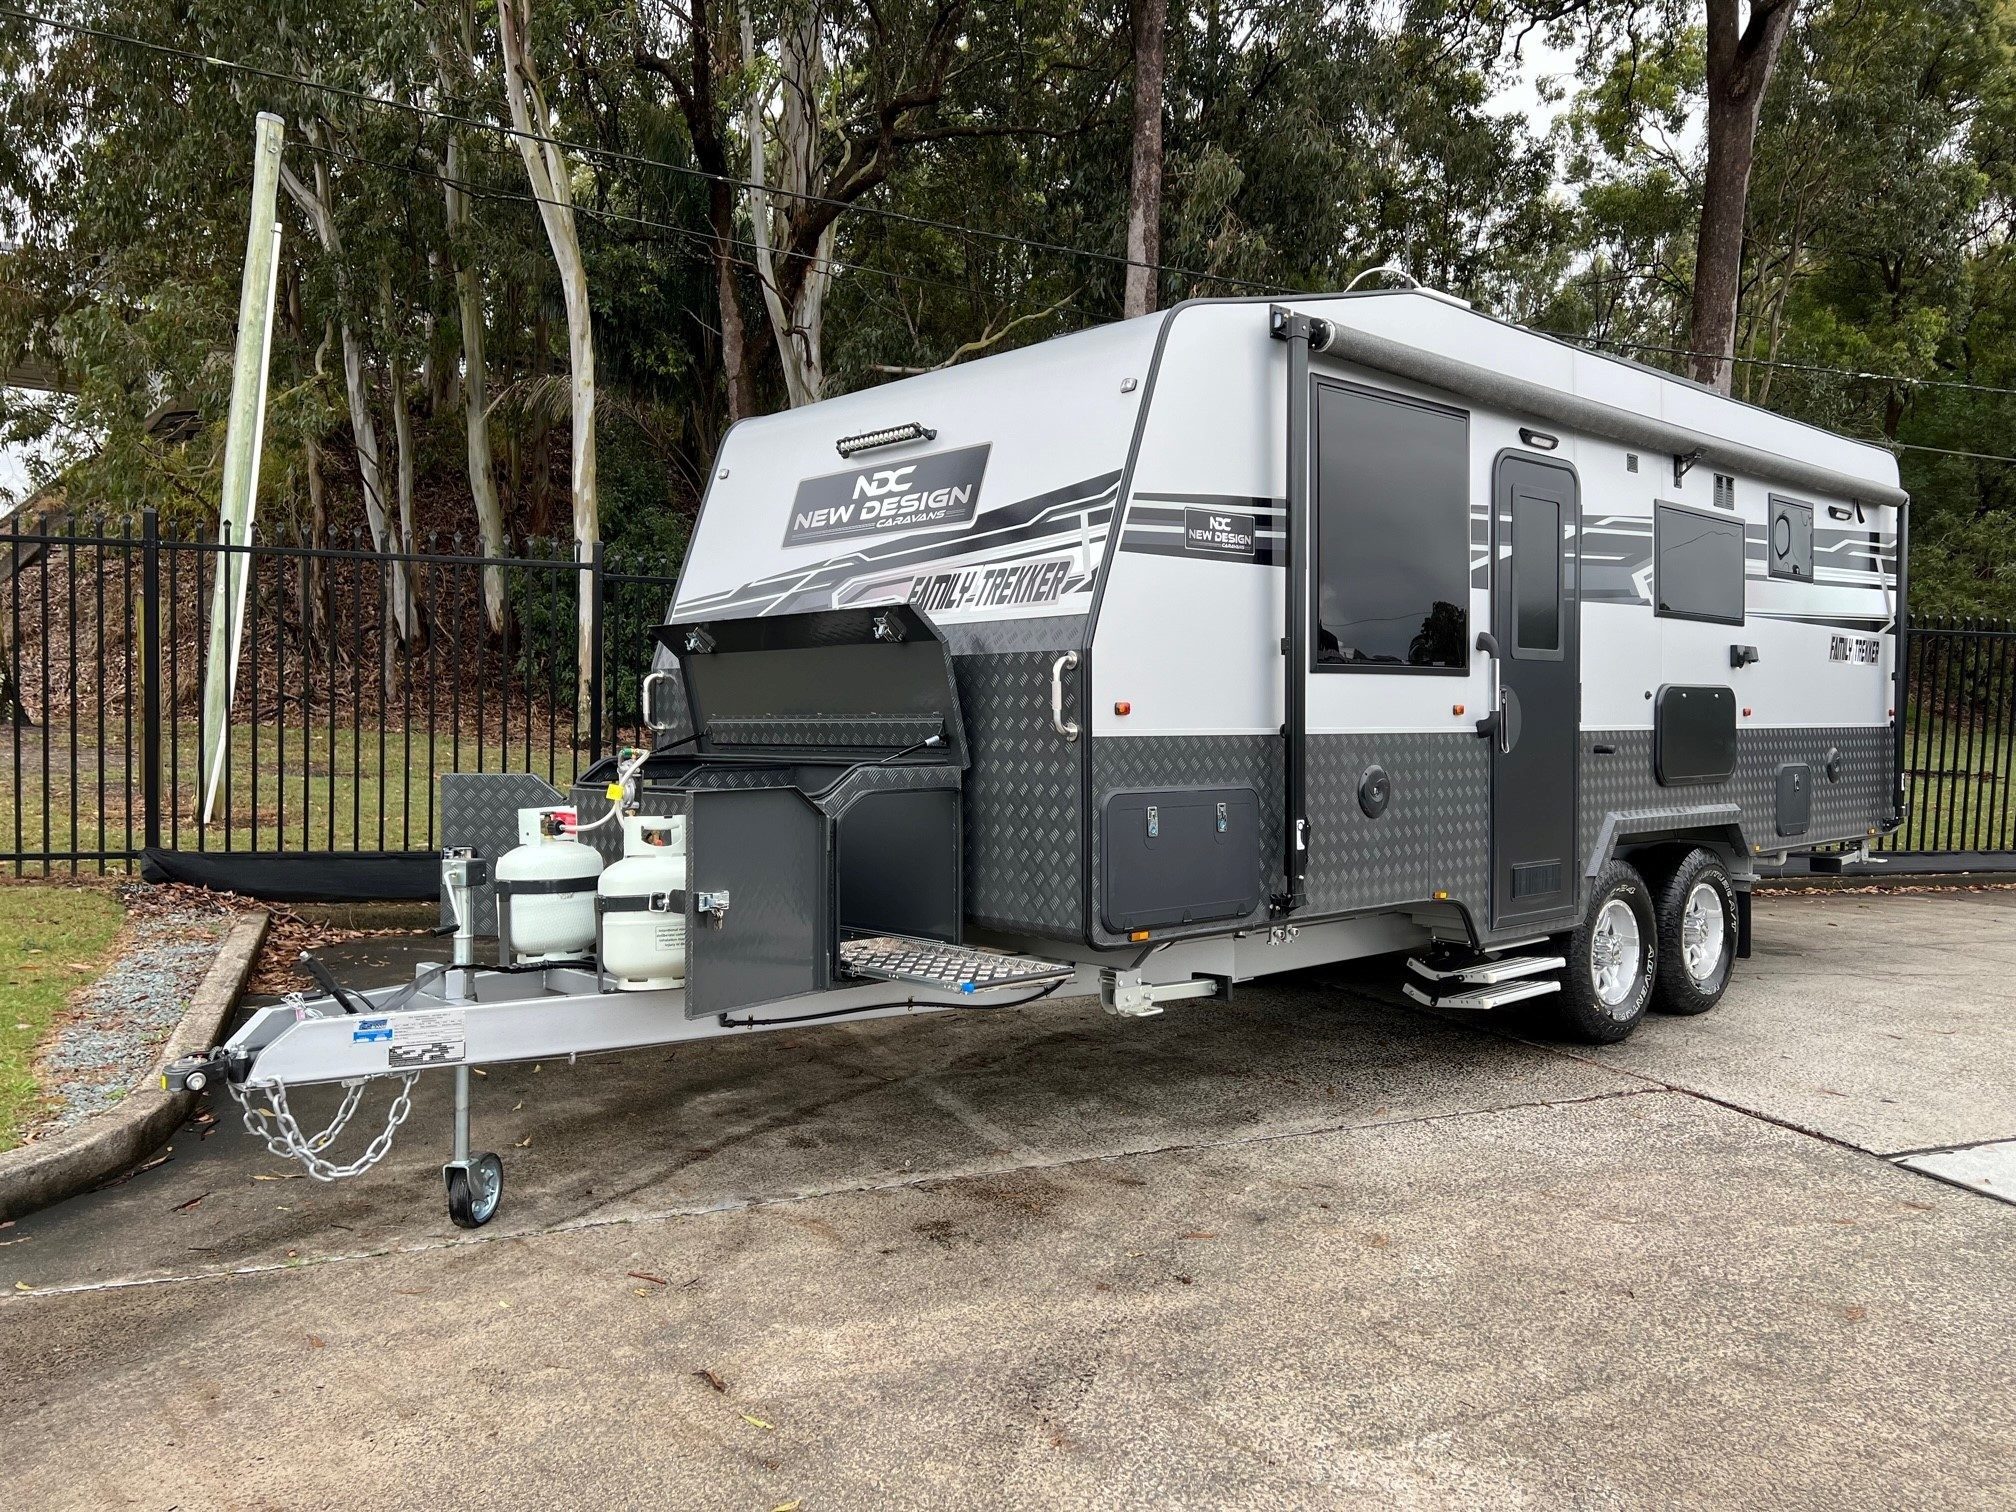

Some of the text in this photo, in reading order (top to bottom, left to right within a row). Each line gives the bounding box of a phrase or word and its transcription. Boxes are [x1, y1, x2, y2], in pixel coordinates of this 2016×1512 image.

[852, 465, 918, 500] NDC
[793, 484, 973, 531] NEW DESIGN
[875, 509, 947, 529] CARAVANS
[1188, 528, 1252, 545] NEW DESIGN
[1209, 515, 1232, 532] NDC
[1610, 944, 1655, 1022] ADVENTURE
